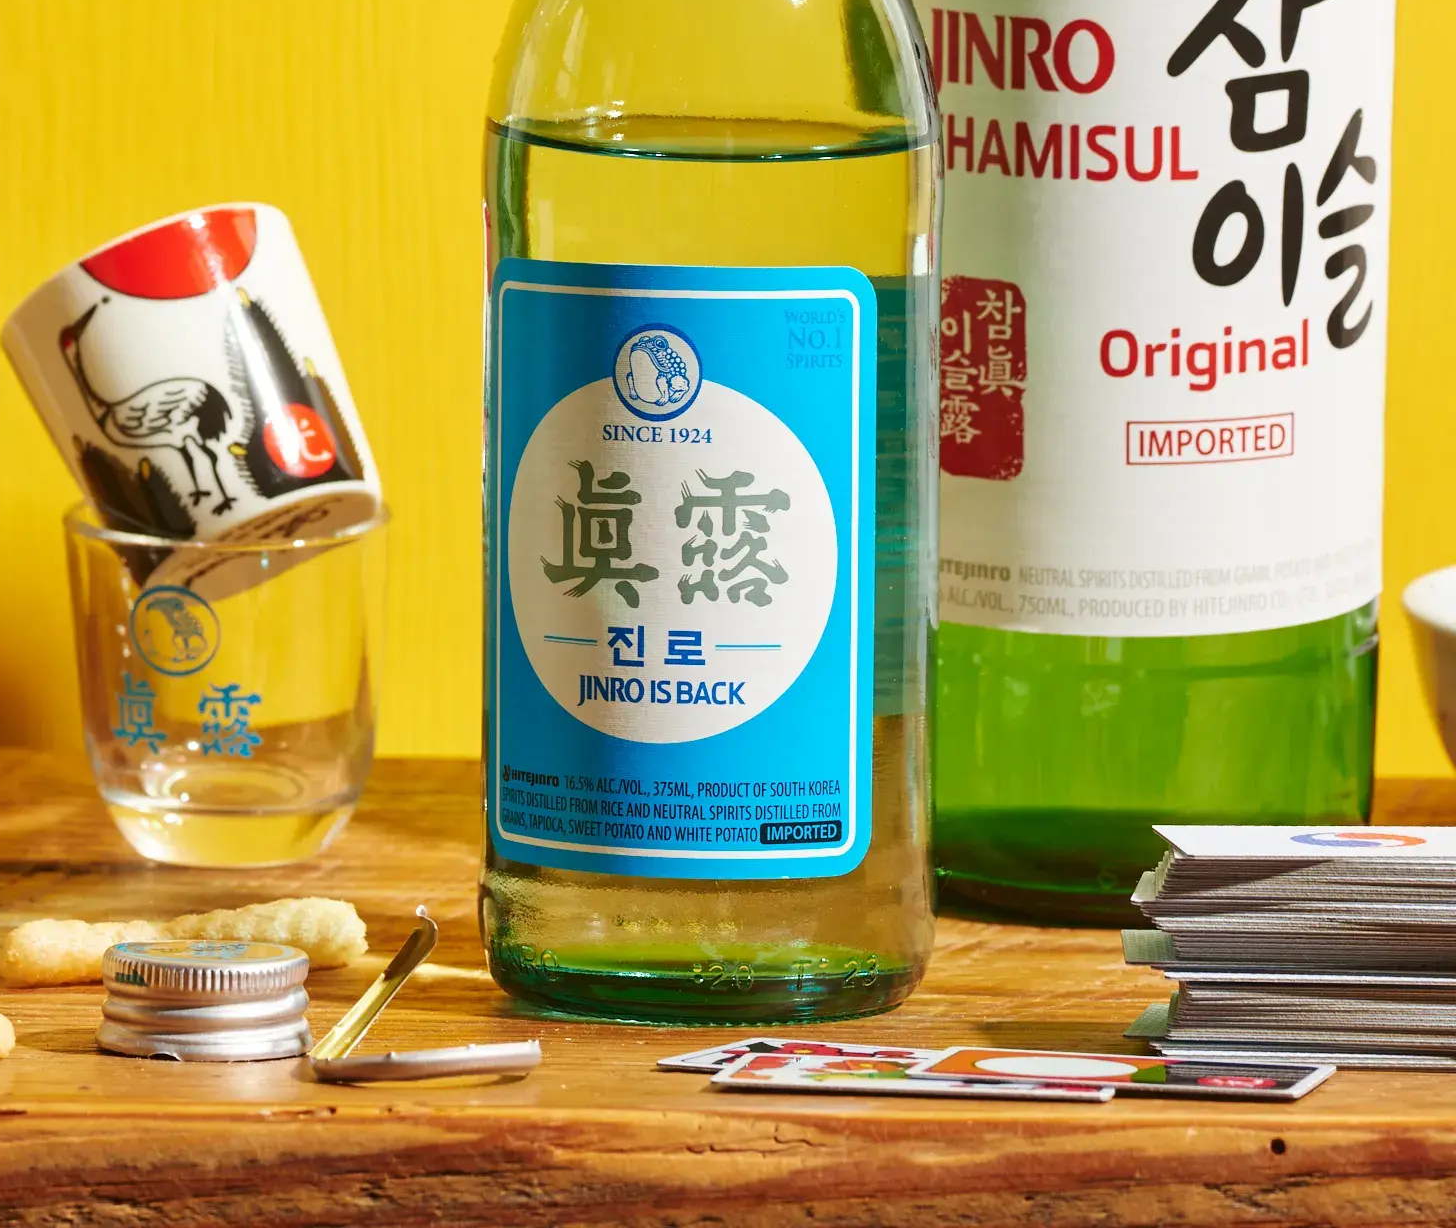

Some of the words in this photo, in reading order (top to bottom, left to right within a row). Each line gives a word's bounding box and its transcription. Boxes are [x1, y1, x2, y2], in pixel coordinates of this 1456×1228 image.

[931, 7, 1116, 96] JINRO
[943, 113, 1199, 183] HAMISUL
[786, 353, 843, 369] SPIRITS
[1099, 318, 1310, 393] Original
[602, 424, 663, 443] SINCE
[669, 427, 712, 444] 1924
[1138, 422, 1287, 458] IMPORTED
[577, 674, 644, 706] JINRO
[651, 680, 672, 704] IS
[676, 681, 746, 705] BACK
[502, 786, 525, 805] SPIRITS
[526, 791, 567, 811] DISTILLED
[569, 798, 598, 815] FROM
[601, 801, 623, 817] RICE
[626, 802, 651, 818] AND
[653, 803, 706, 821] NEUTRAL
[709, 805, 752, 821] SPIRITS
[755, 804, 808, 821] DISTILLED
[812, 803, 841, 819] FROM
[564, 775, 594, 791] 16.5%
[653, 781, 694, 799] 375ML,
[697, 782, 751, 798] PRODUCT
[753, 782, 767, 797] OF
[770, 782, 805, 797] SOUTH
[809, 779, 841, 796] KOREA
[529, 813, 567, 835] TAPIOCA,
[568, 819, 602, 837] SWEET
[604, 822, 644, 840] POTATO
[646, 825, 672, 841] AND
[674, 826, 712, 843] WHITE
[715, 826, 758, 843] POTATO
[766, 823, 837, 841] IMPORTED
